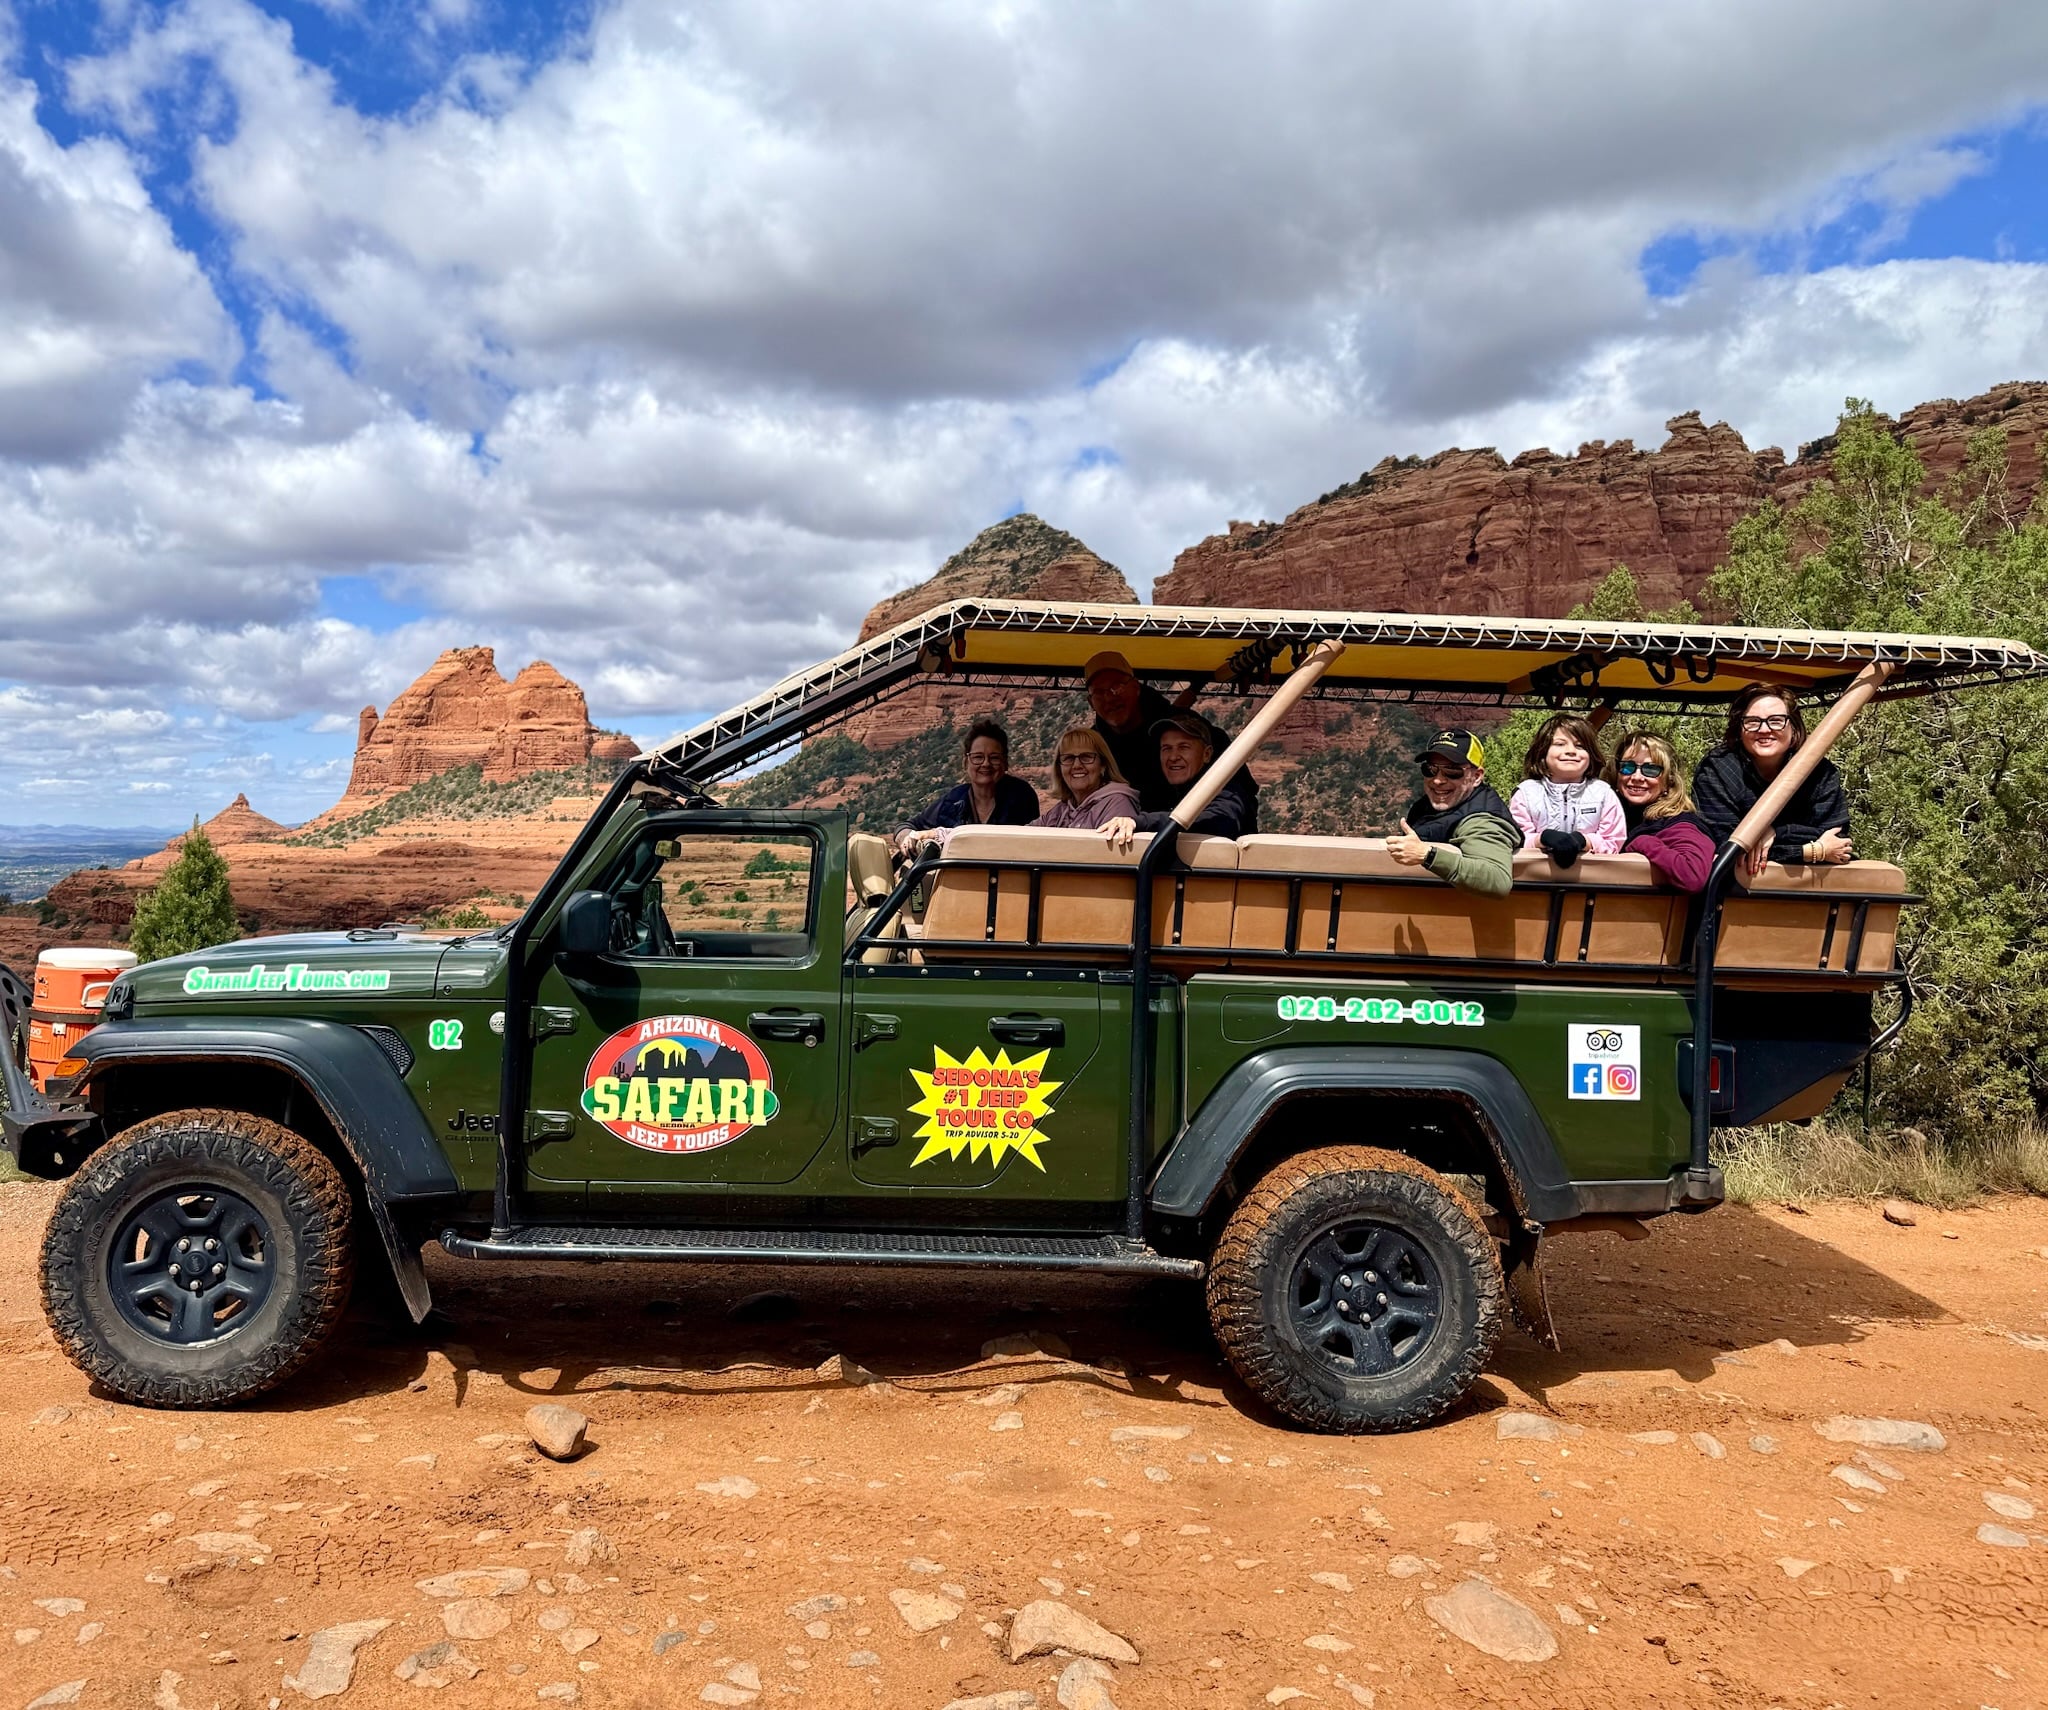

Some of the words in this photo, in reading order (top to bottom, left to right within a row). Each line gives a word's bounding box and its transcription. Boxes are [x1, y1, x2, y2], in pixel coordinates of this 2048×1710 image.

[1279, 996, 1484, 1024] 928-282-3012
[430, 1020, 463, 1048] 82
[638, 1016, 721, 1044] ARIZONA
[932, 1067, 1041, 1088] SEDONA'S
[592, 1076, 768, 1126] SAFARI
[943, 1089, 969, 1106] #1
[977, 1089, 1028, 1108] JEEP
[936, 1108, 998, 1128] TOUR
[1003, 1110, 1035, 1129] CO
[627, 1124, 669, 1146] JEEP
[672, 1124, 730, 1150] TOURS
[945, 1130, 963, 1138] TRIP
[965, 1130, 999, 1139] ADVISOR
